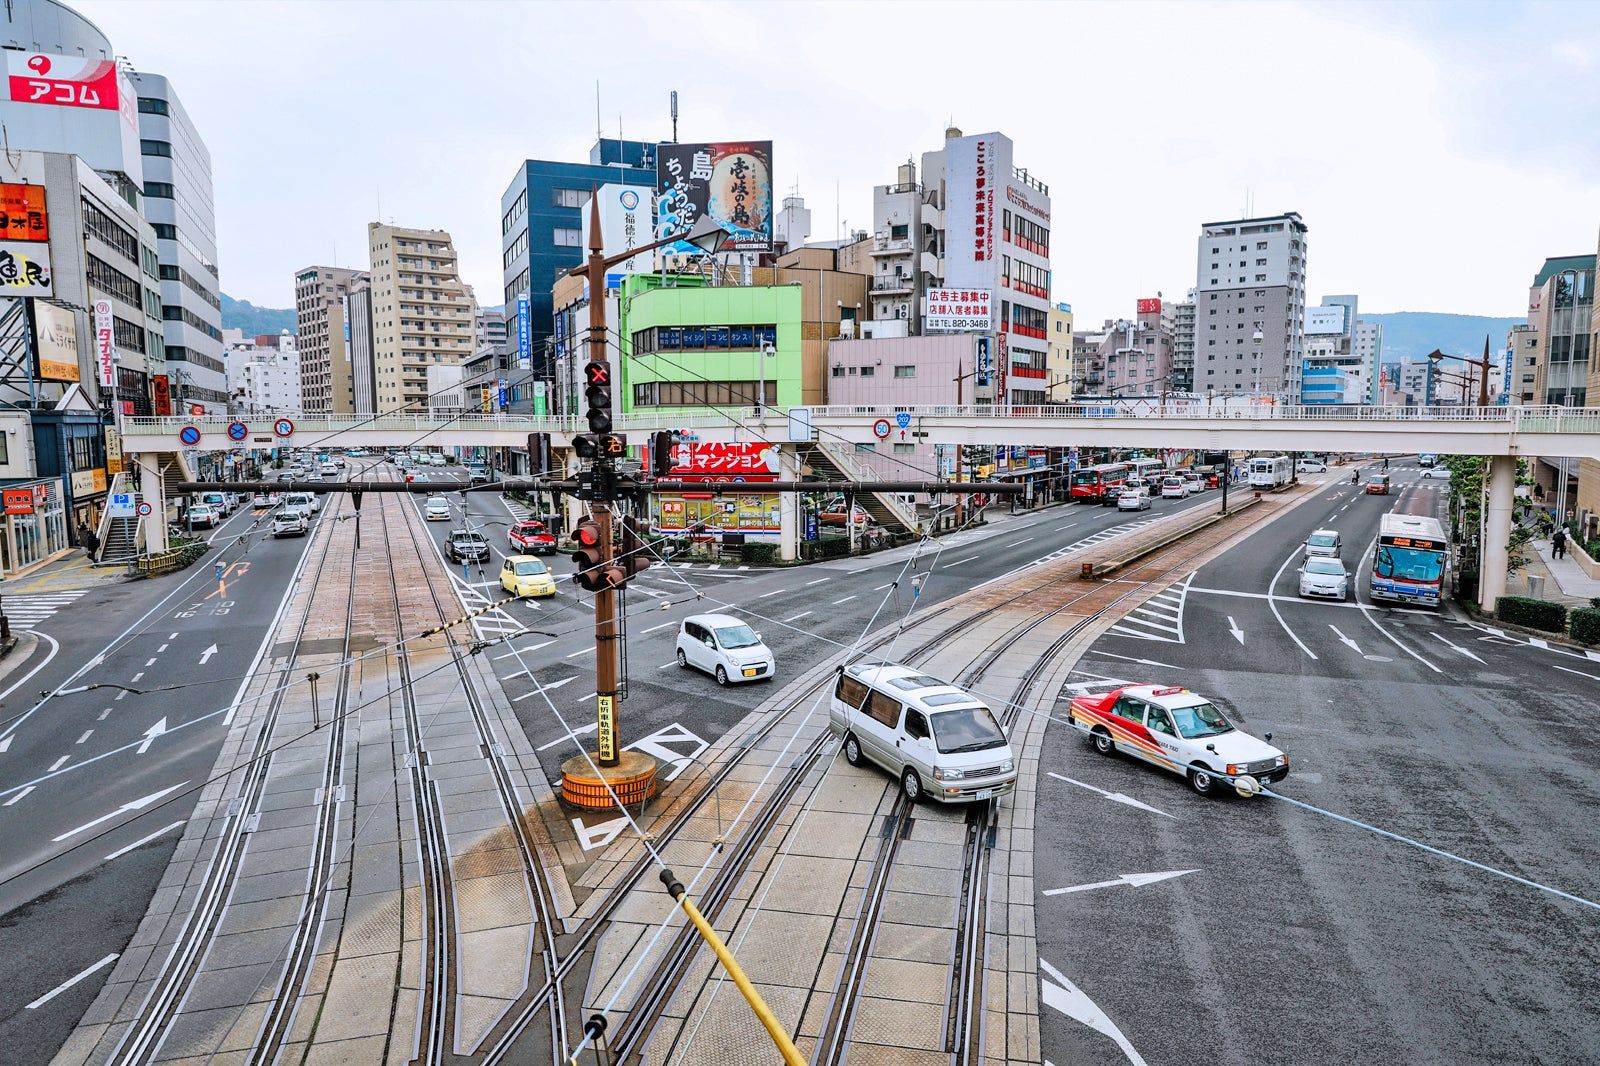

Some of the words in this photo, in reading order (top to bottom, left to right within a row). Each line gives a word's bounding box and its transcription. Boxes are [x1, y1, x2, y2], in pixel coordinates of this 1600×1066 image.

[29, 81, 100, 105] アコム
[730, 156, 749, 225] 壱岐の島
[930, 291, 989, 302] 広告主募集中
[930, 305, 988, 315] 店舗入居者募集
[952, 320, 989, 328] 820-3468
[877, 423, 888, 434] 50
[607, 437, 622, 452] 右
[694, 452, 767, 469] マンション
[600, 699, 610, 758] 右折車軌道外待機
